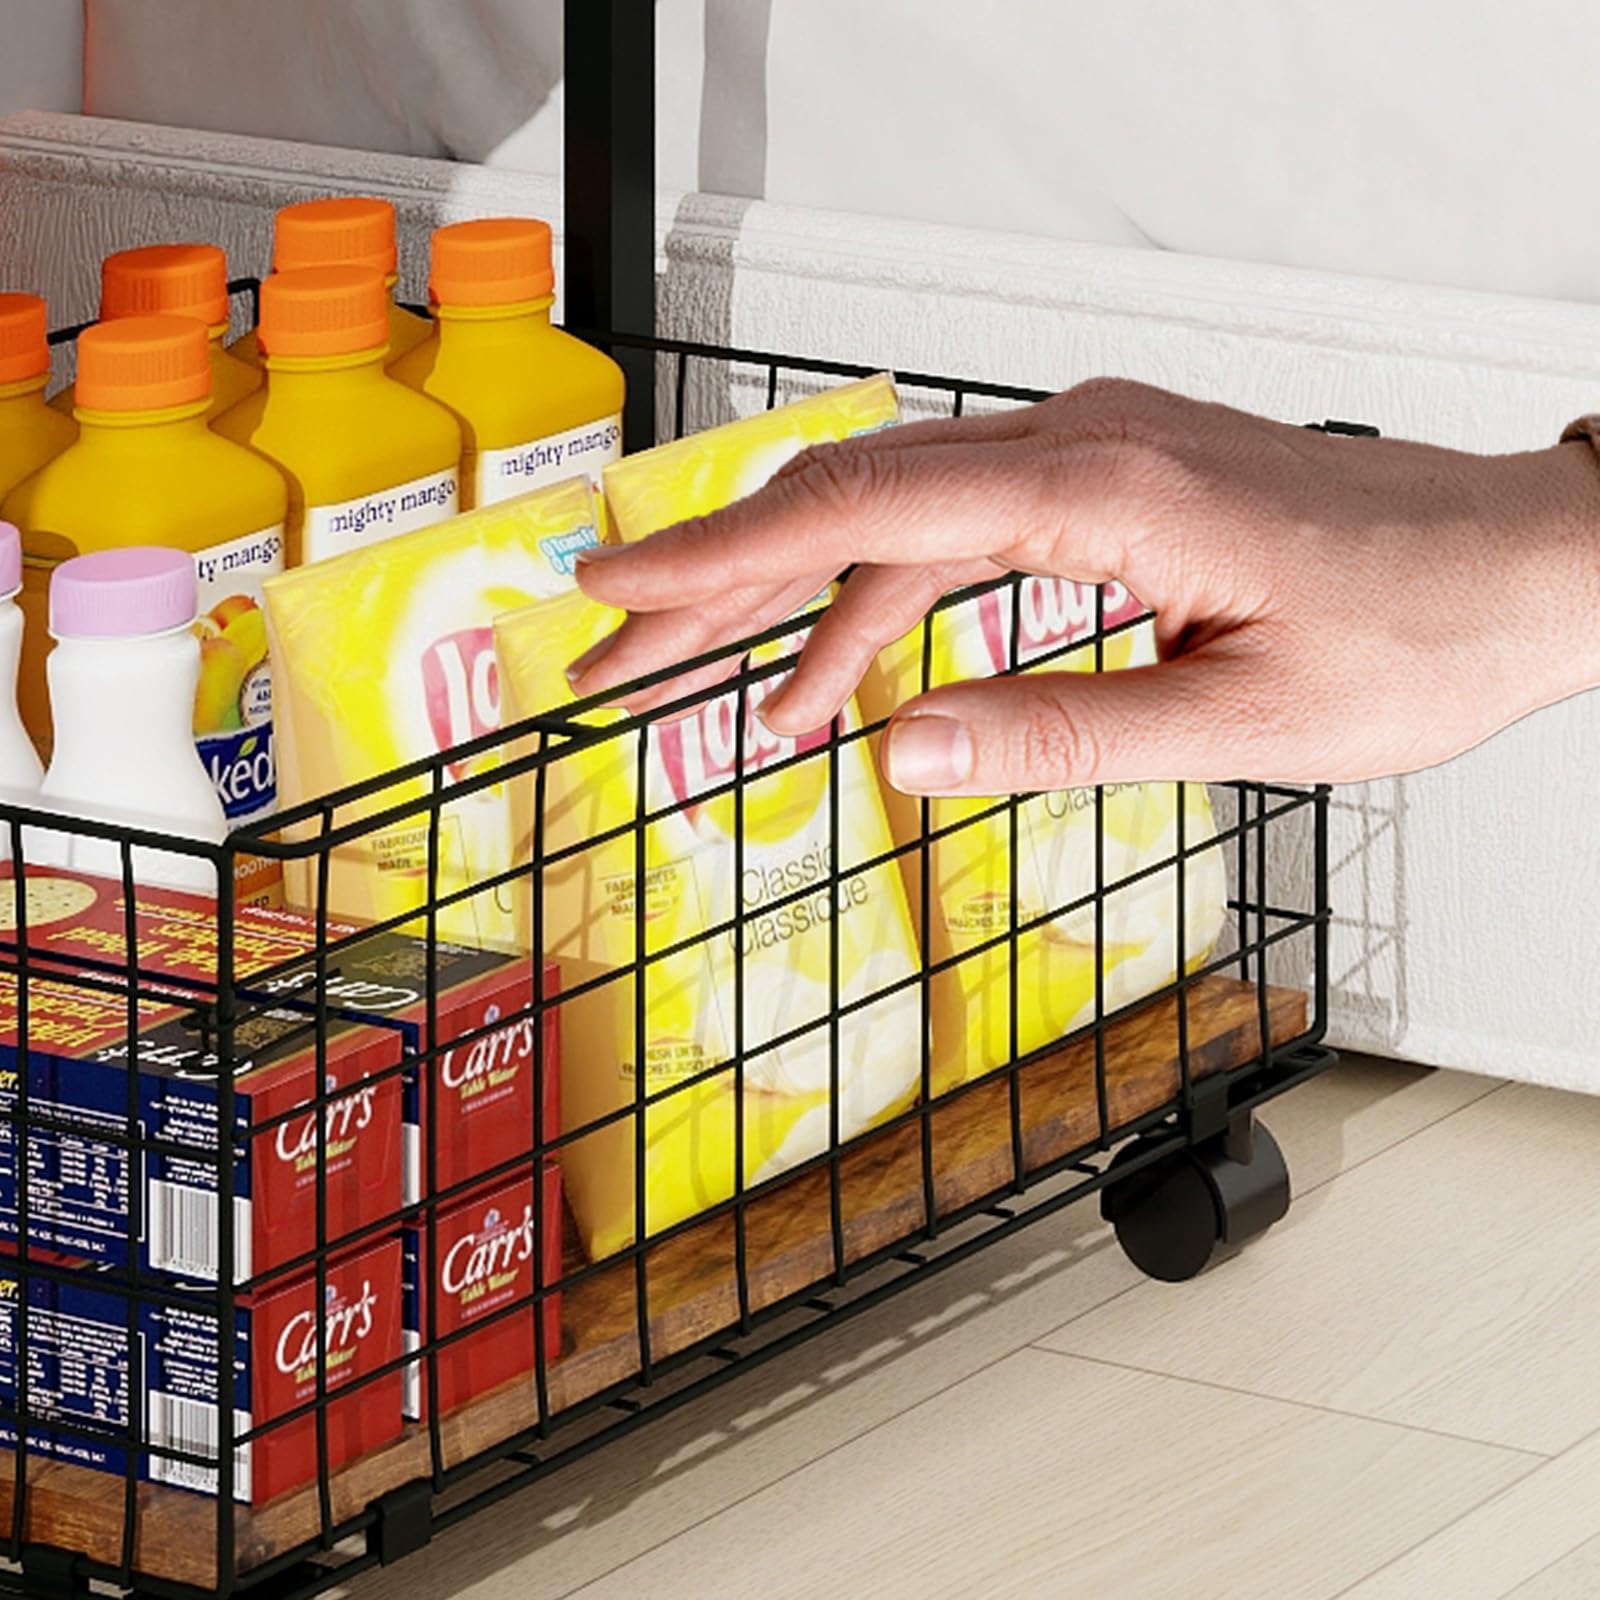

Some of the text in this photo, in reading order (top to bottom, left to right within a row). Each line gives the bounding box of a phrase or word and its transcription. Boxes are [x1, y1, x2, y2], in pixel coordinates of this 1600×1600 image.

[502, 425, 620, 476] mighty mango
[329, 479, 456, 533] mighty mango
[222, 536, 281, 573] mango
[210, 733, 276, 805] ked
[266, 971, 420, 1010] Car's
[443, 1002, 534, 1089] Carr's
[443, 1205, 534, 1295] Carr's
[276, 1280, 378, 1374] Carr's
